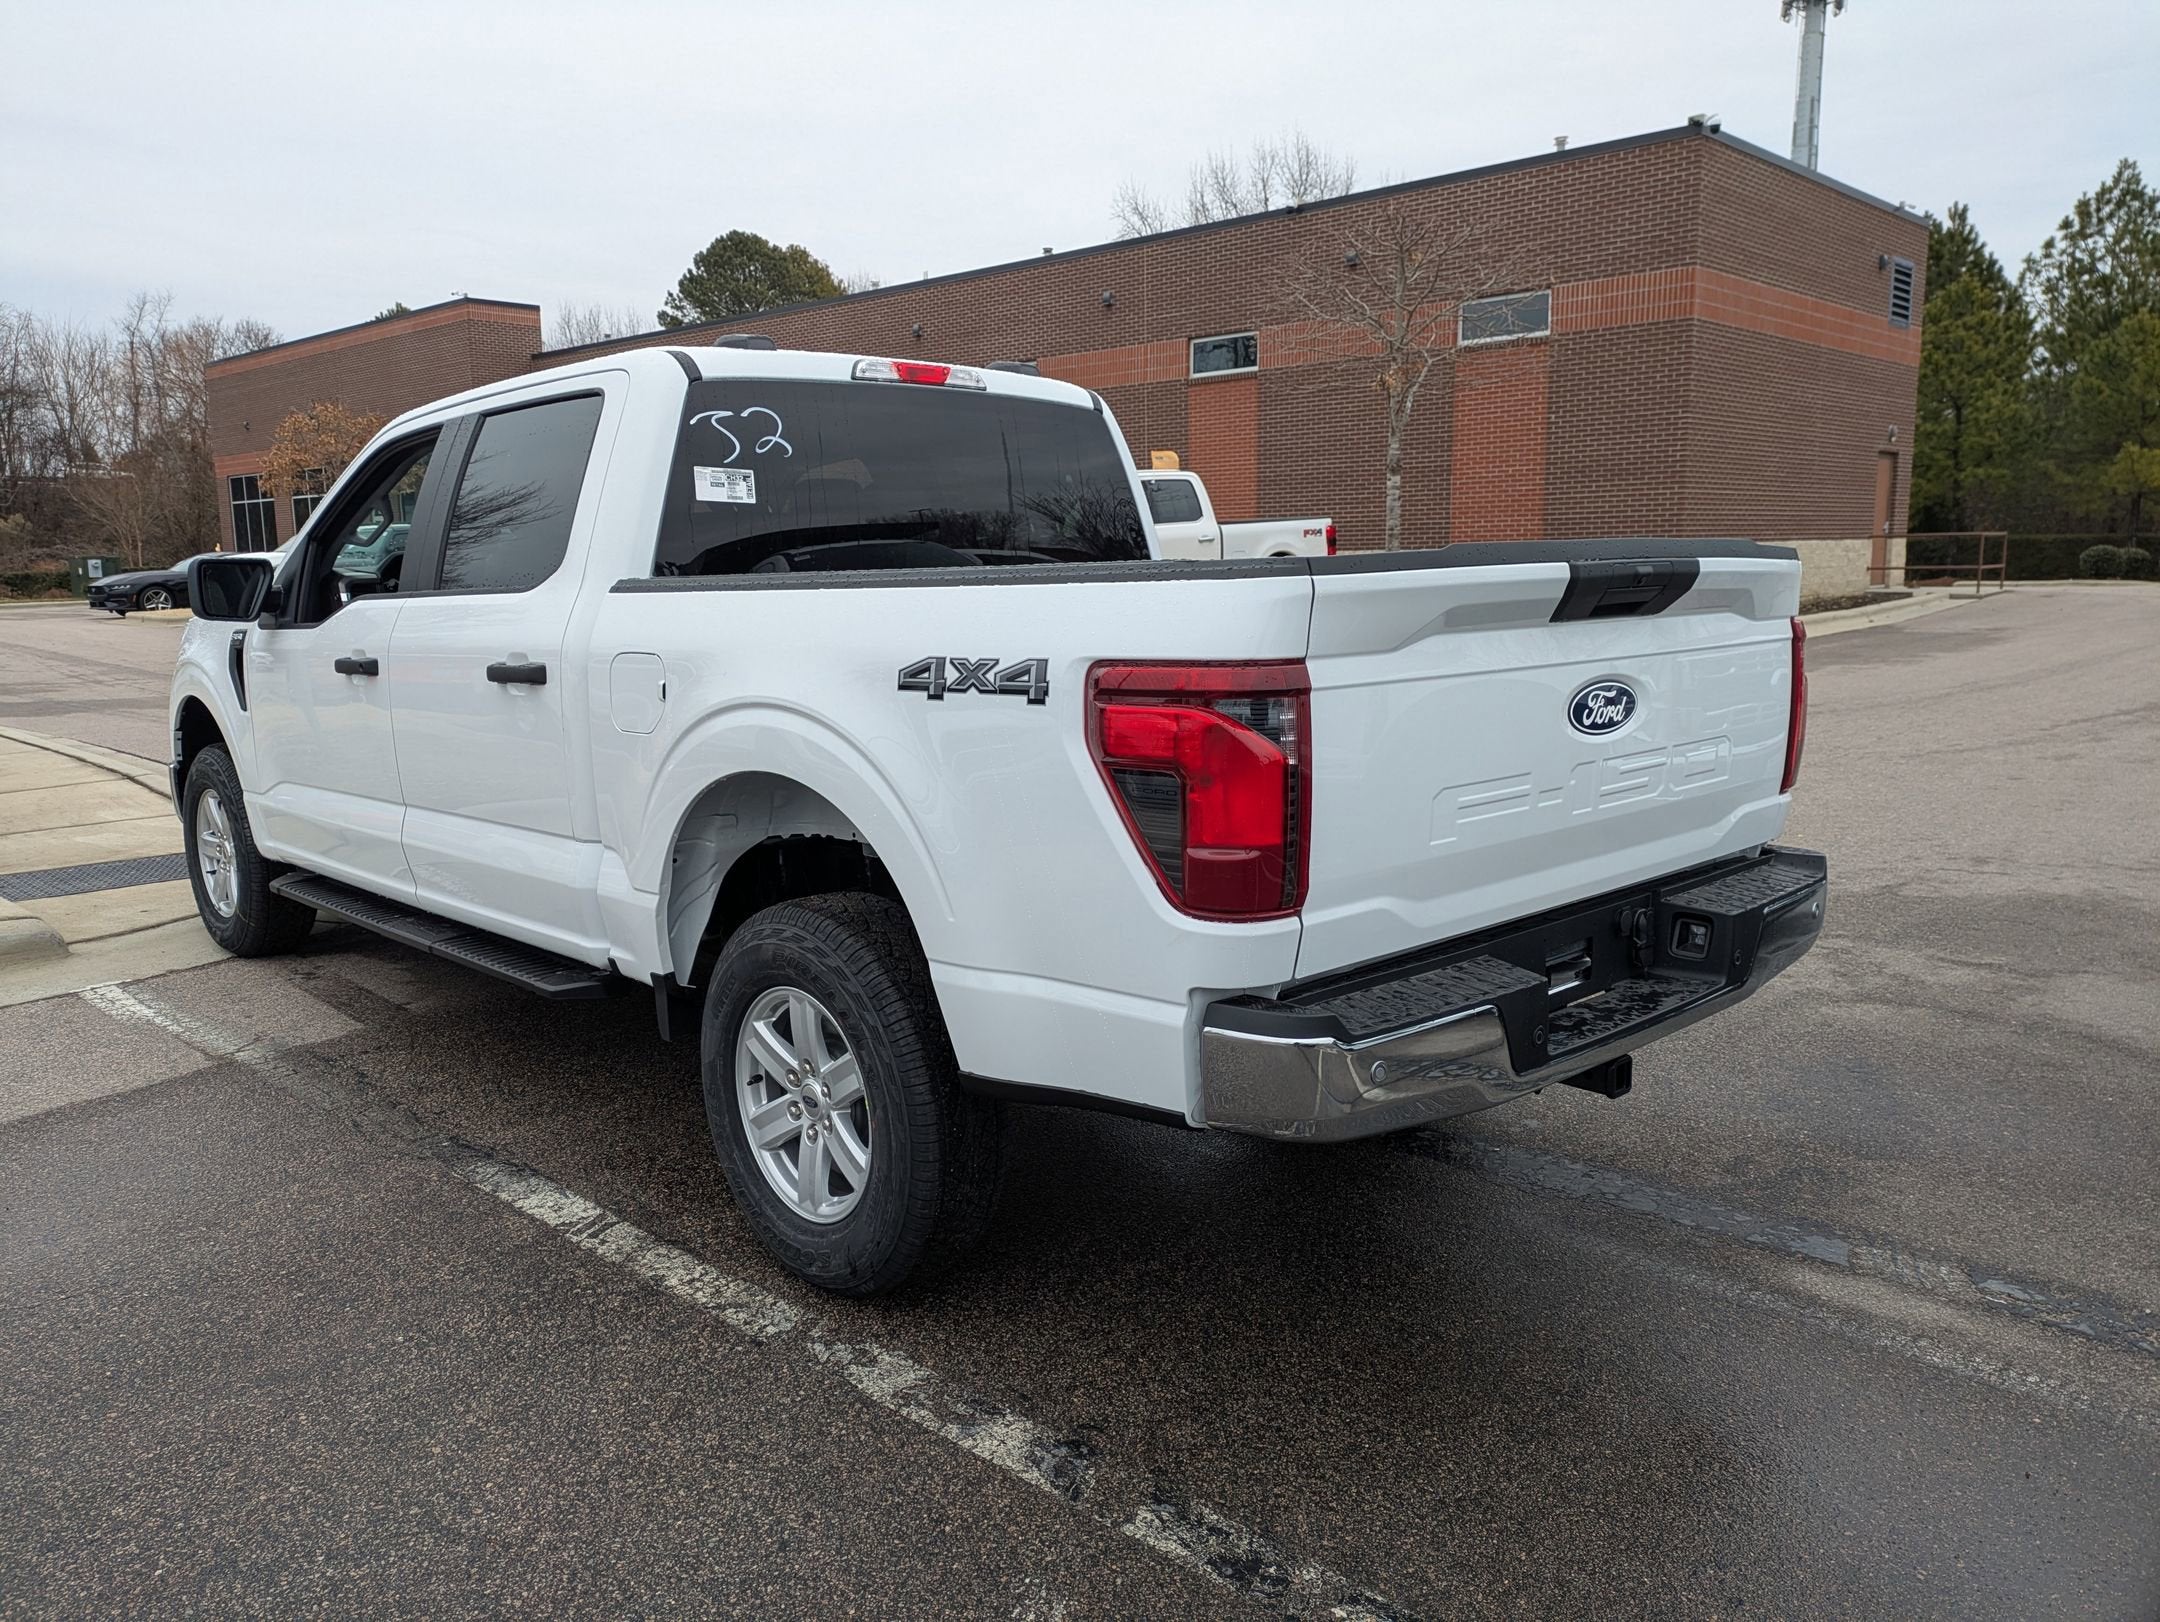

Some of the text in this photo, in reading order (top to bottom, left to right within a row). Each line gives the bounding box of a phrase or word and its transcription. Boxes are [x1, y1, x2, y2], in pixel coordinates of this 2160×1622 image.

[1303, 528, 1323, 538] FX4
[1582, 690, 1628, 726] Ford
[1430, 734, 1732, 846] F-150
